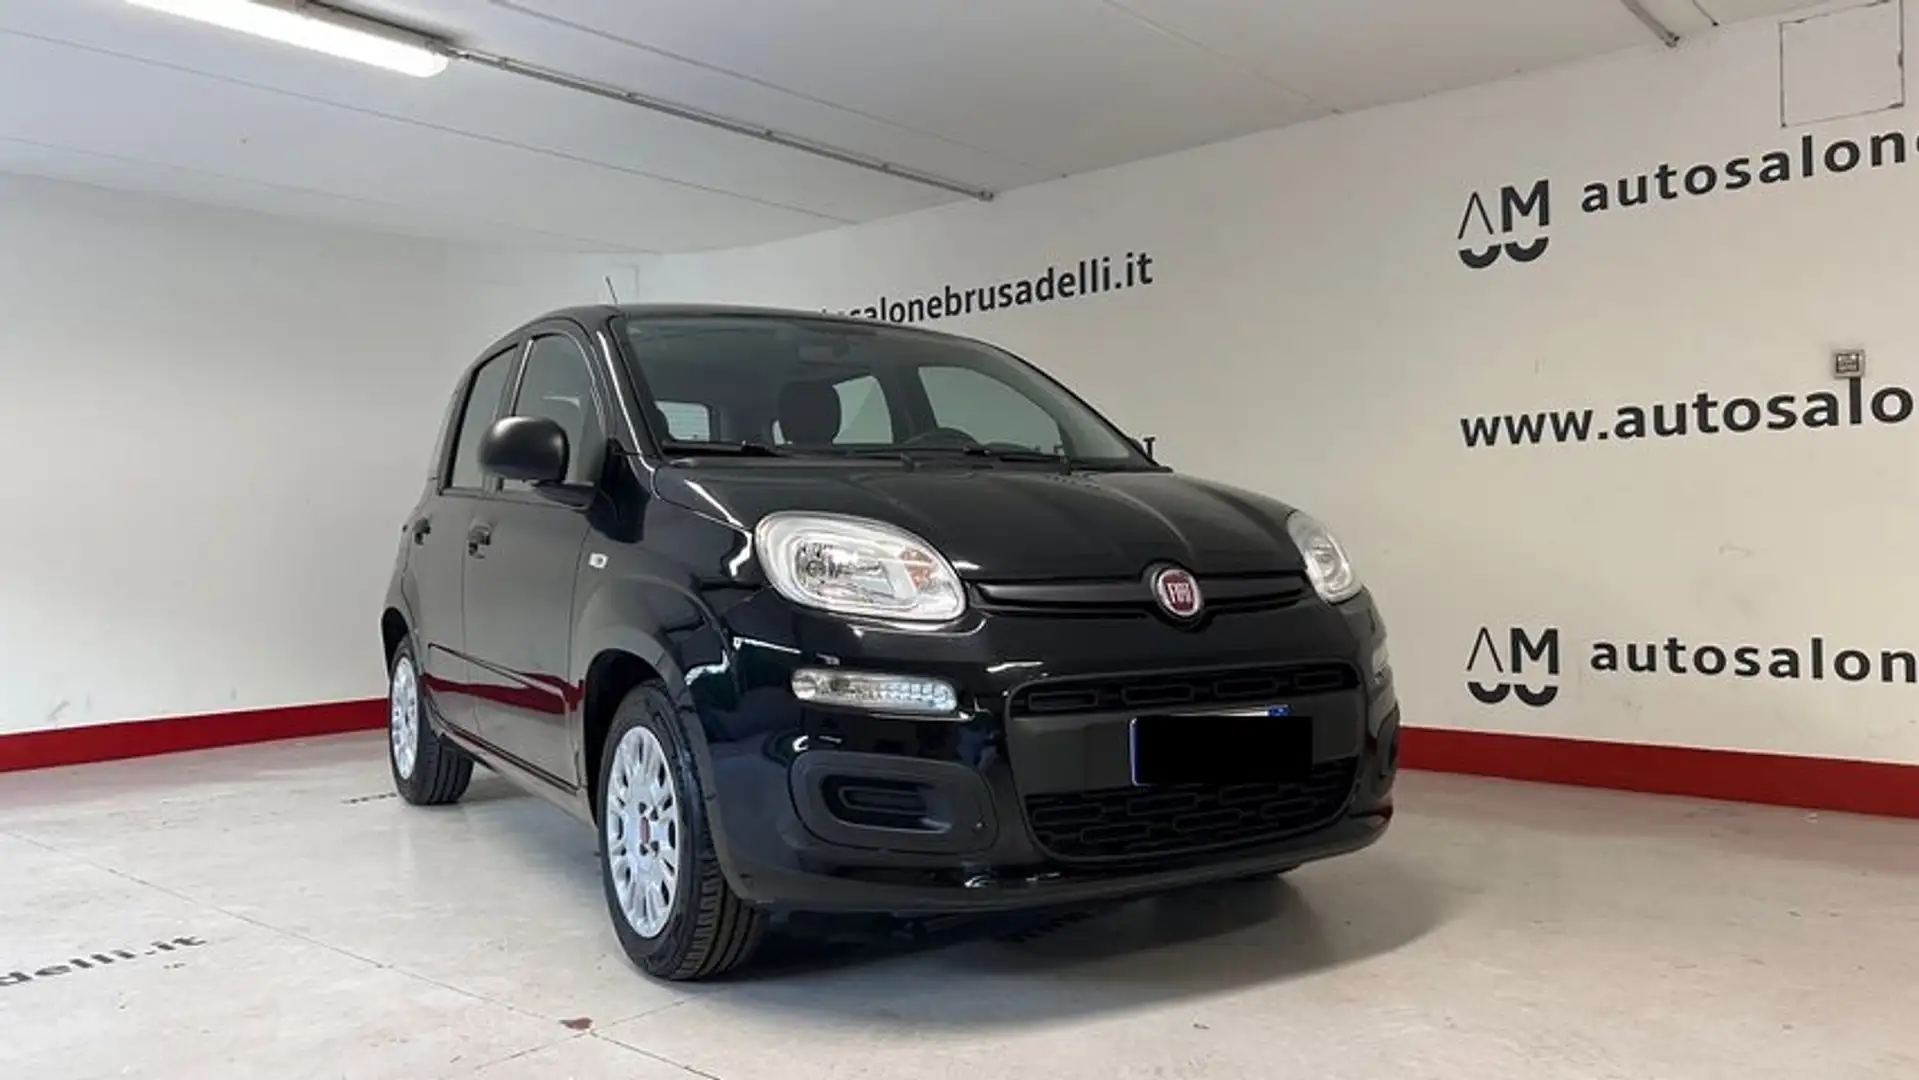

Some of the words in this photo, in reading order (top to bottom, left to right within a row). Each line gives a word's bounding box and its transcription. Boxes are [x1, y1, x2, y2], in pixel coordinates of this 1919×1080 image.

[1581, 131, 1919, 213] autosalon
[1460, 377, 1914, 448] www.autosalo
[1590, 637, 1917, 683] autosalon
